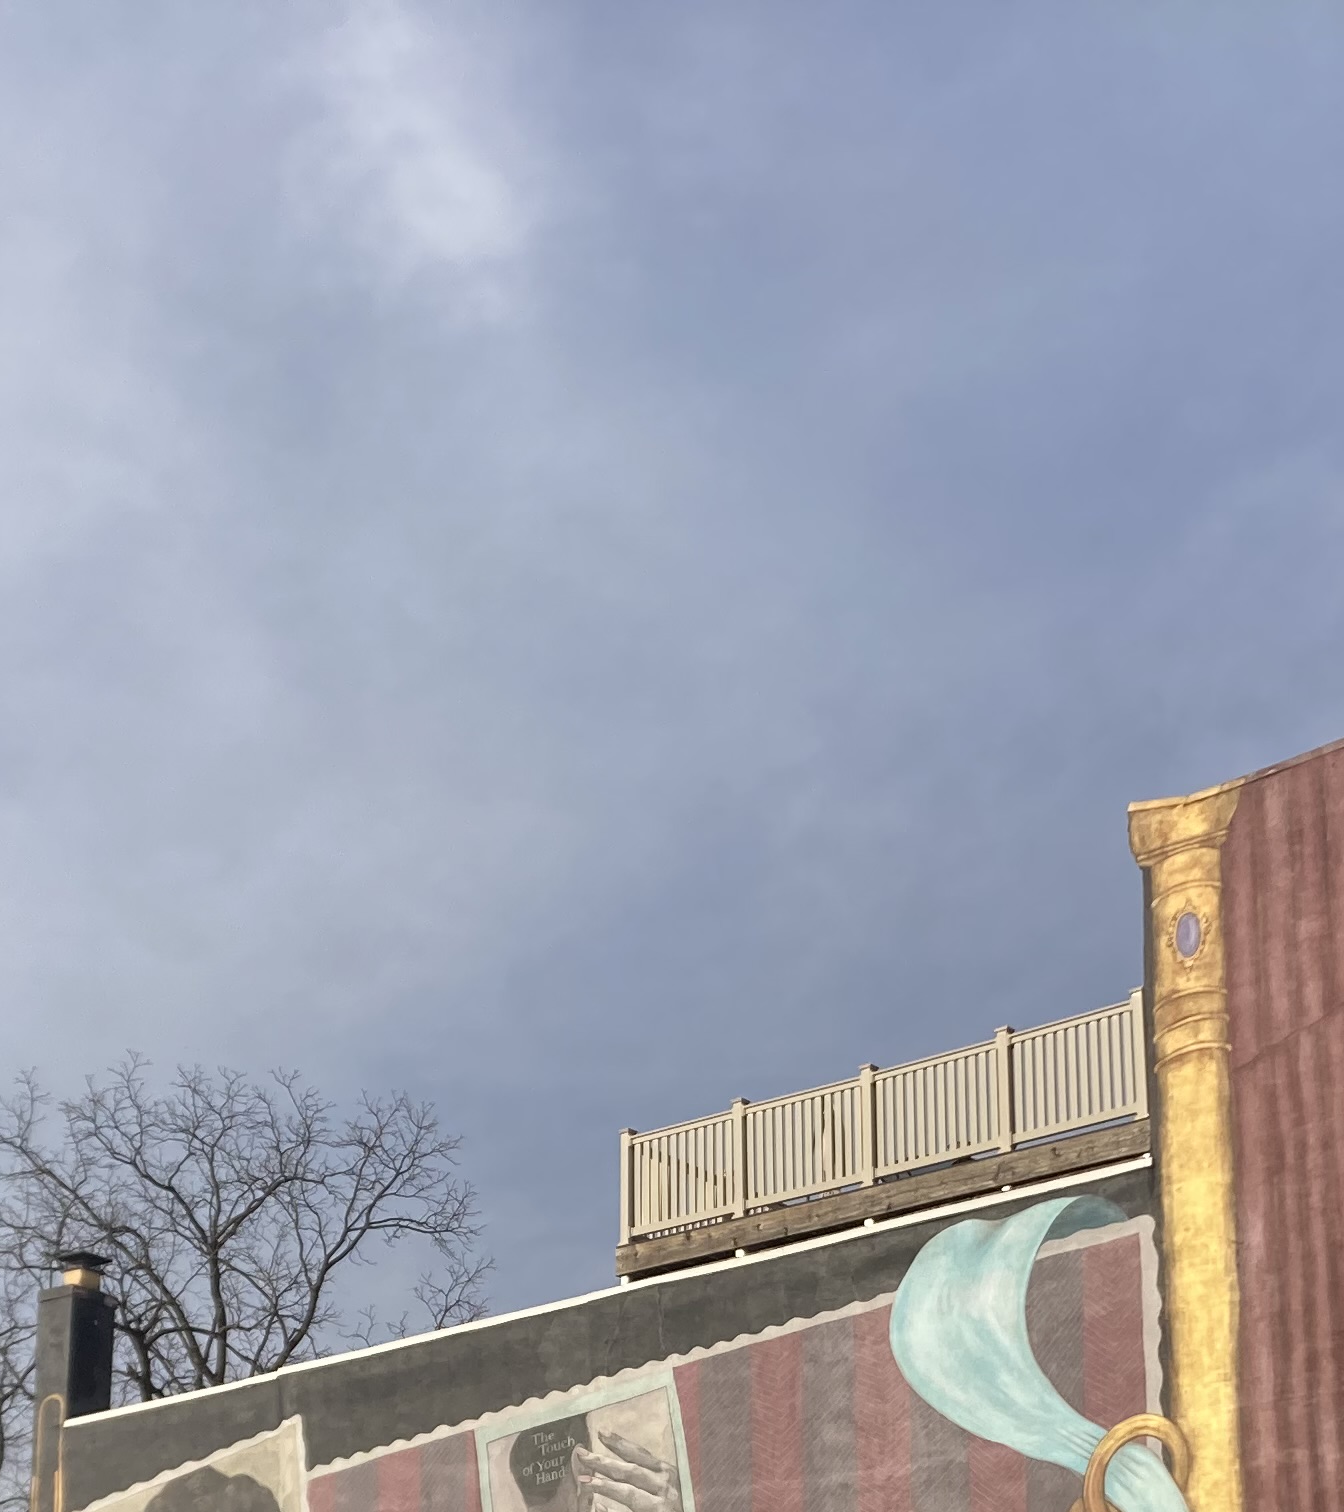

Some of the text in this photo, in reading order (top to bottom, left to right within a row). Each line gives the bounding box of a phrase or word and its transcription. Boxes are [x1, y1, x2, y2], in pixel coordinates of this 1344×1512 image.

[532, 1431, 555, 1446] The
[537, 1436, 576, 1456] Touch
[522, 1455, 566, 1477] of Your
